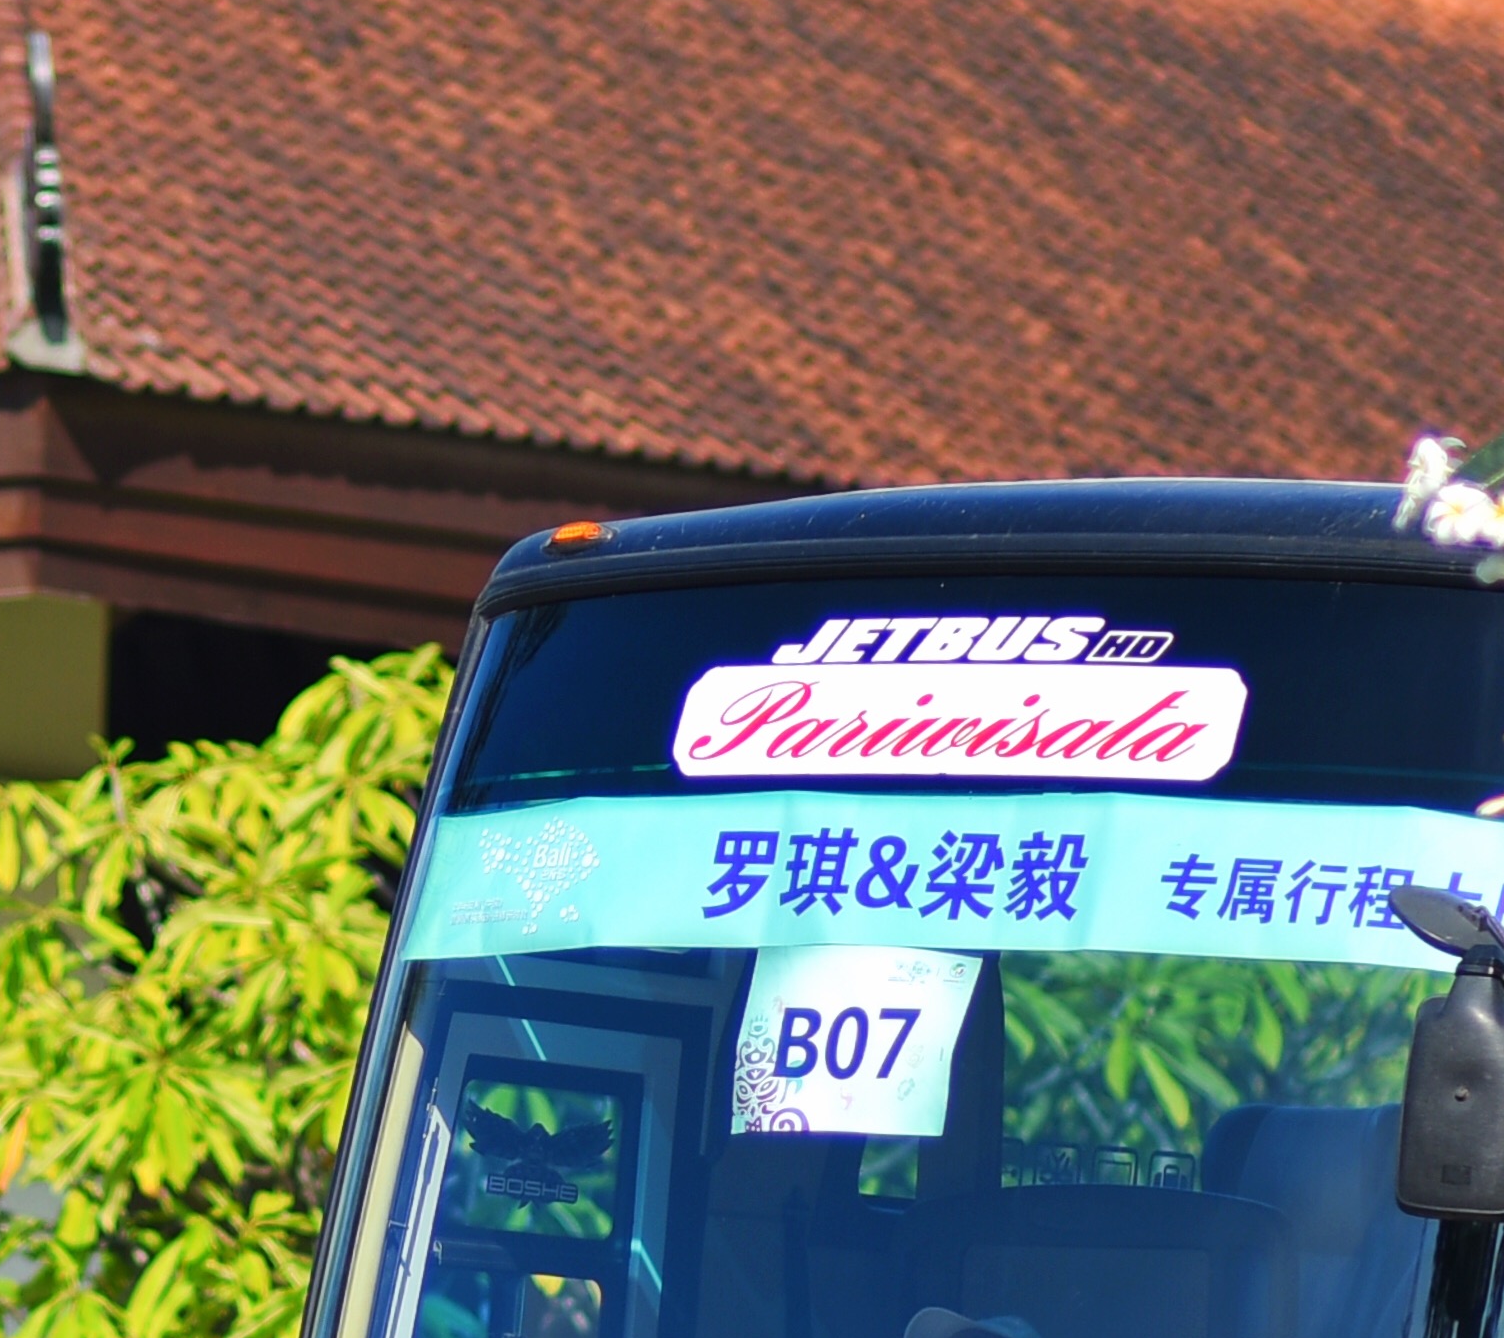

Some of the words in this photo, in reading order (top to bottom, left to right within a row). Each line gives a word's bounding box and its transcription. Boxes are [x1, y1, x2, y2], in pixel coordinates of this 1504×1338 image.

[772, 617, 1104, 664] JETBUS
[1090, 633, 1172, 662] HD
[688, 680, 1209, 762] Pariwisata
[533, 842, 573, 868] Bali
[701, 827, 1089, 921] 罗琪&梁毅
[773, 1006, 922, 1080] B07
[488, 1175, 578, 1202] BOSHE
